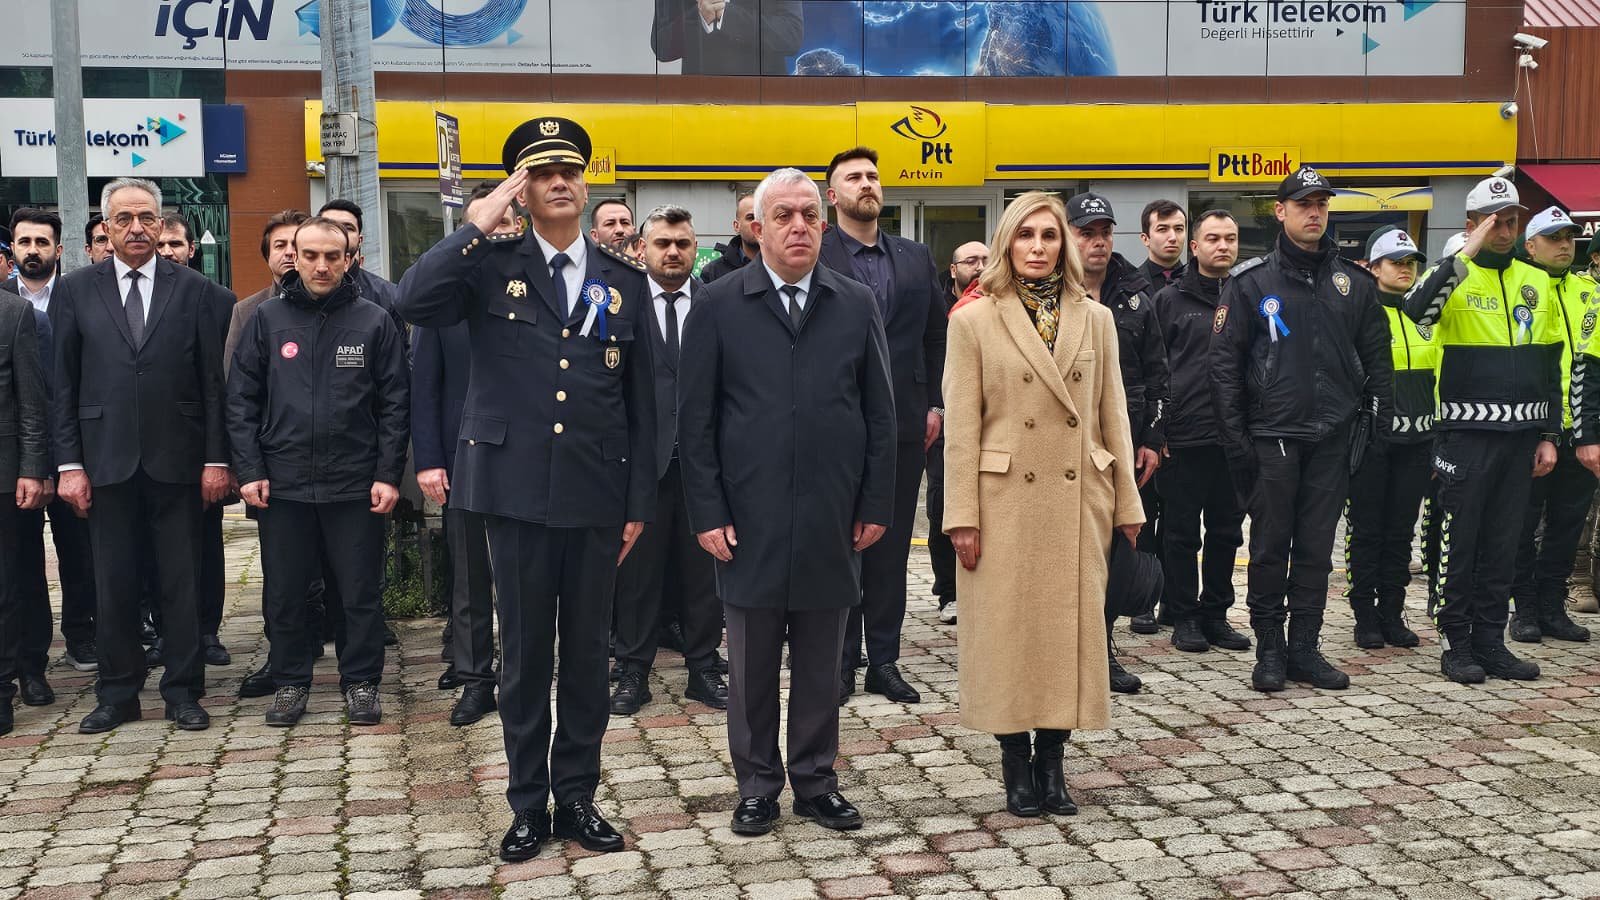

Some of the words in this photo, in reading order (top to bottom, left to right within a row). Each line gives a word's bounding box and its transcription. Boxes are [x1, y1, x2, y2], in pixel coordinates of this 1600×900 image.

[1196, 0, 1258, 23] Türk
[1267, 0, 1386, 23] Telekom
[1201, 27, 1247, 41] Değerli
[1252, 27, 1315, 39] Hissettirir
[87, 130, 149, 146] lekom
[921, 141, 953, 165] Ptt
[1218, 153, 1292, 176] PttBank
[898, 169, 943, 179] Artvin
[336, 345, 363, 355] AFAD
